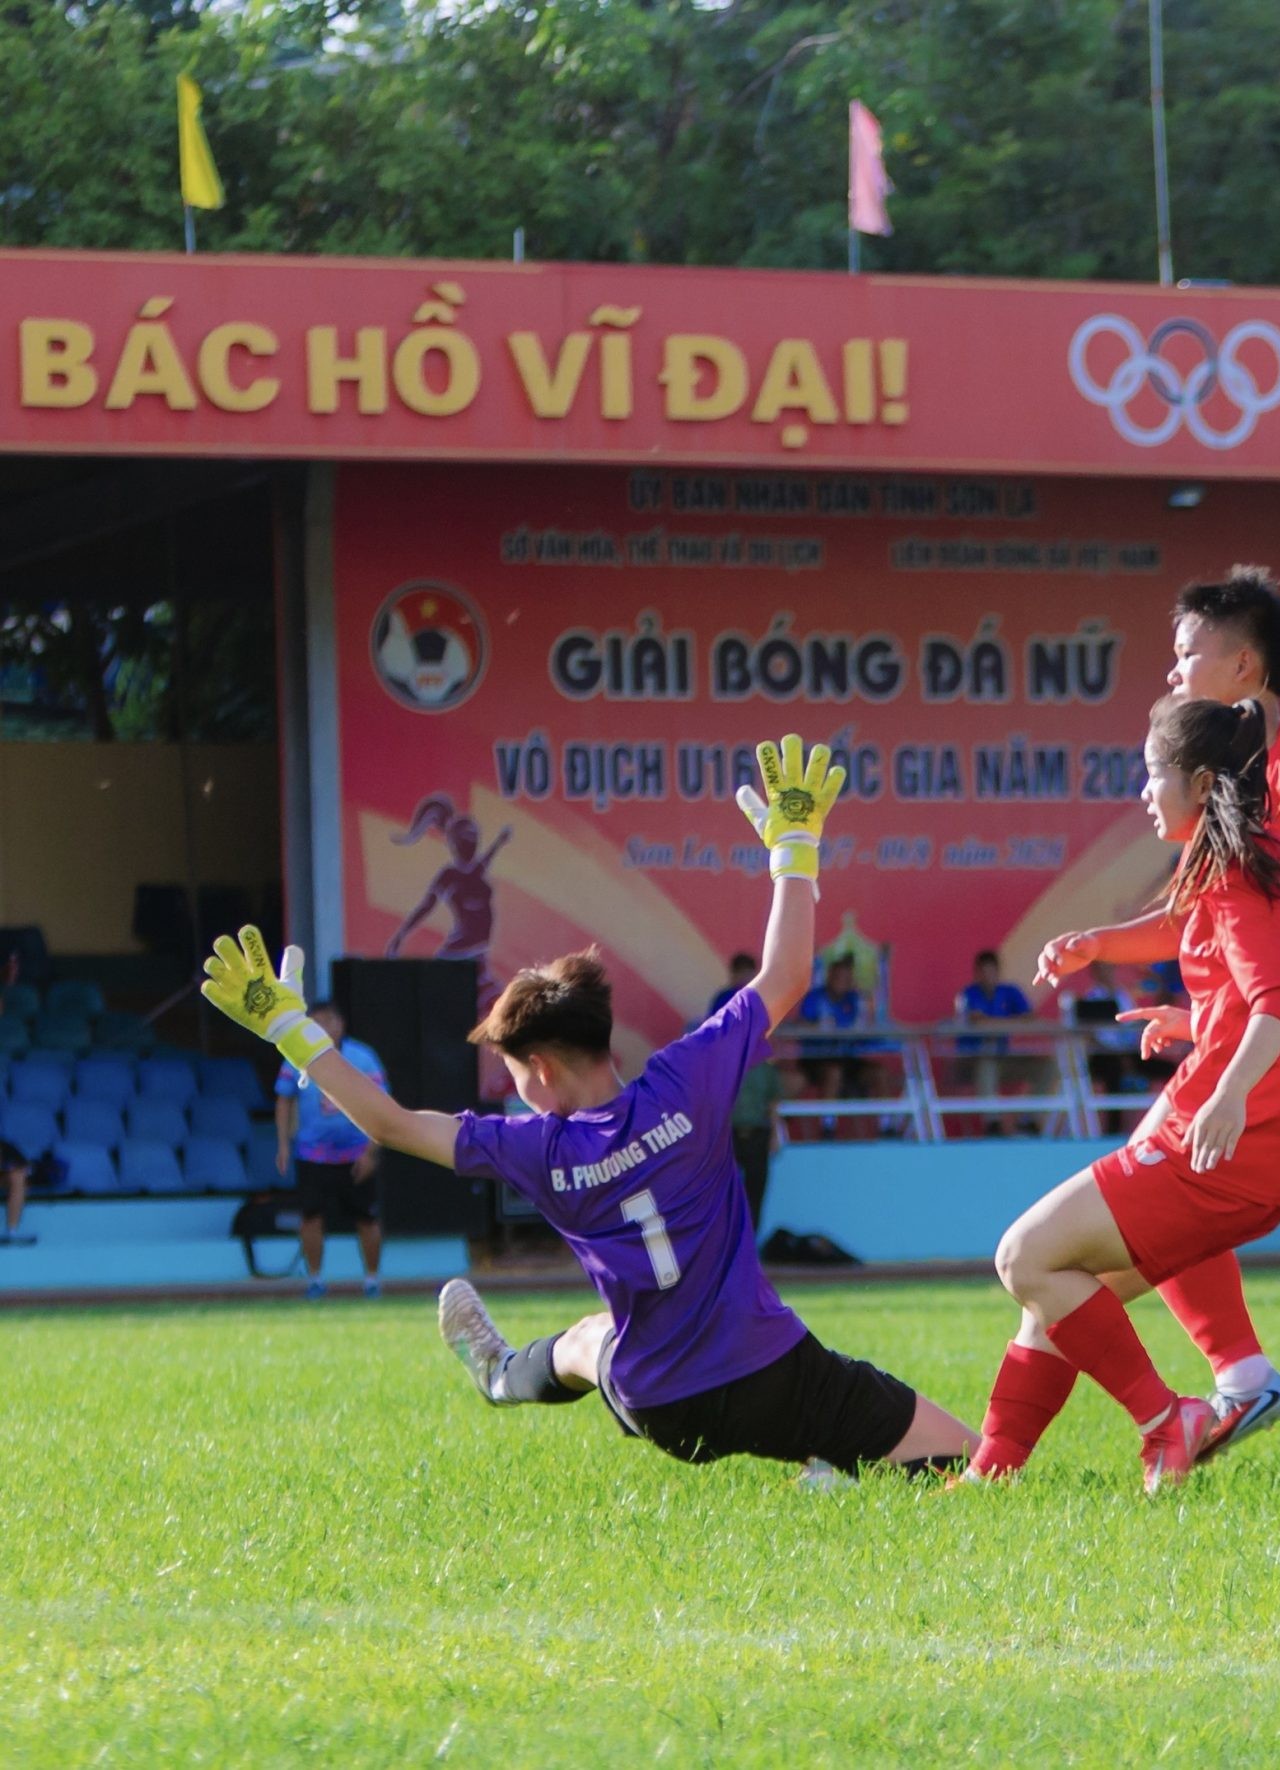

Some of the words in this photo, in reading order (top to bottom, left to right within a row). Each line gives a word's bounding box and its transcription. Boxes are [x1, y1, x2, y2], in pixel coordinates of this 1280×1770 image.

[20, 296, 281, 413] BÁC
[306, 282, 482, 416] HỒ
[509, 304, 643, 419] VĨ
[658, 335, 909, 449] ĐẠI!
[554, 614, 691, 698] GIẢI
[714, 614, 902, 698] BÓNG
[922, 620, 1008, 699] ĐÁ
[1028, 620, 1117, 699] NỮ
[495, 730, 551, 796] VÔ
[564, 742, 665, 812] ĐỊCH
[678, 743, 756, 797] U16
[895, 744, 963, 800] GIA
[973, 732, 1071, 800] NĂM
[1082, 744, 1147, 799] 202
[551, 1168, 572, 1192] B.
[641, 1112, 693, 1154] THẢO
[620, 1189, 681, 1290] 1
